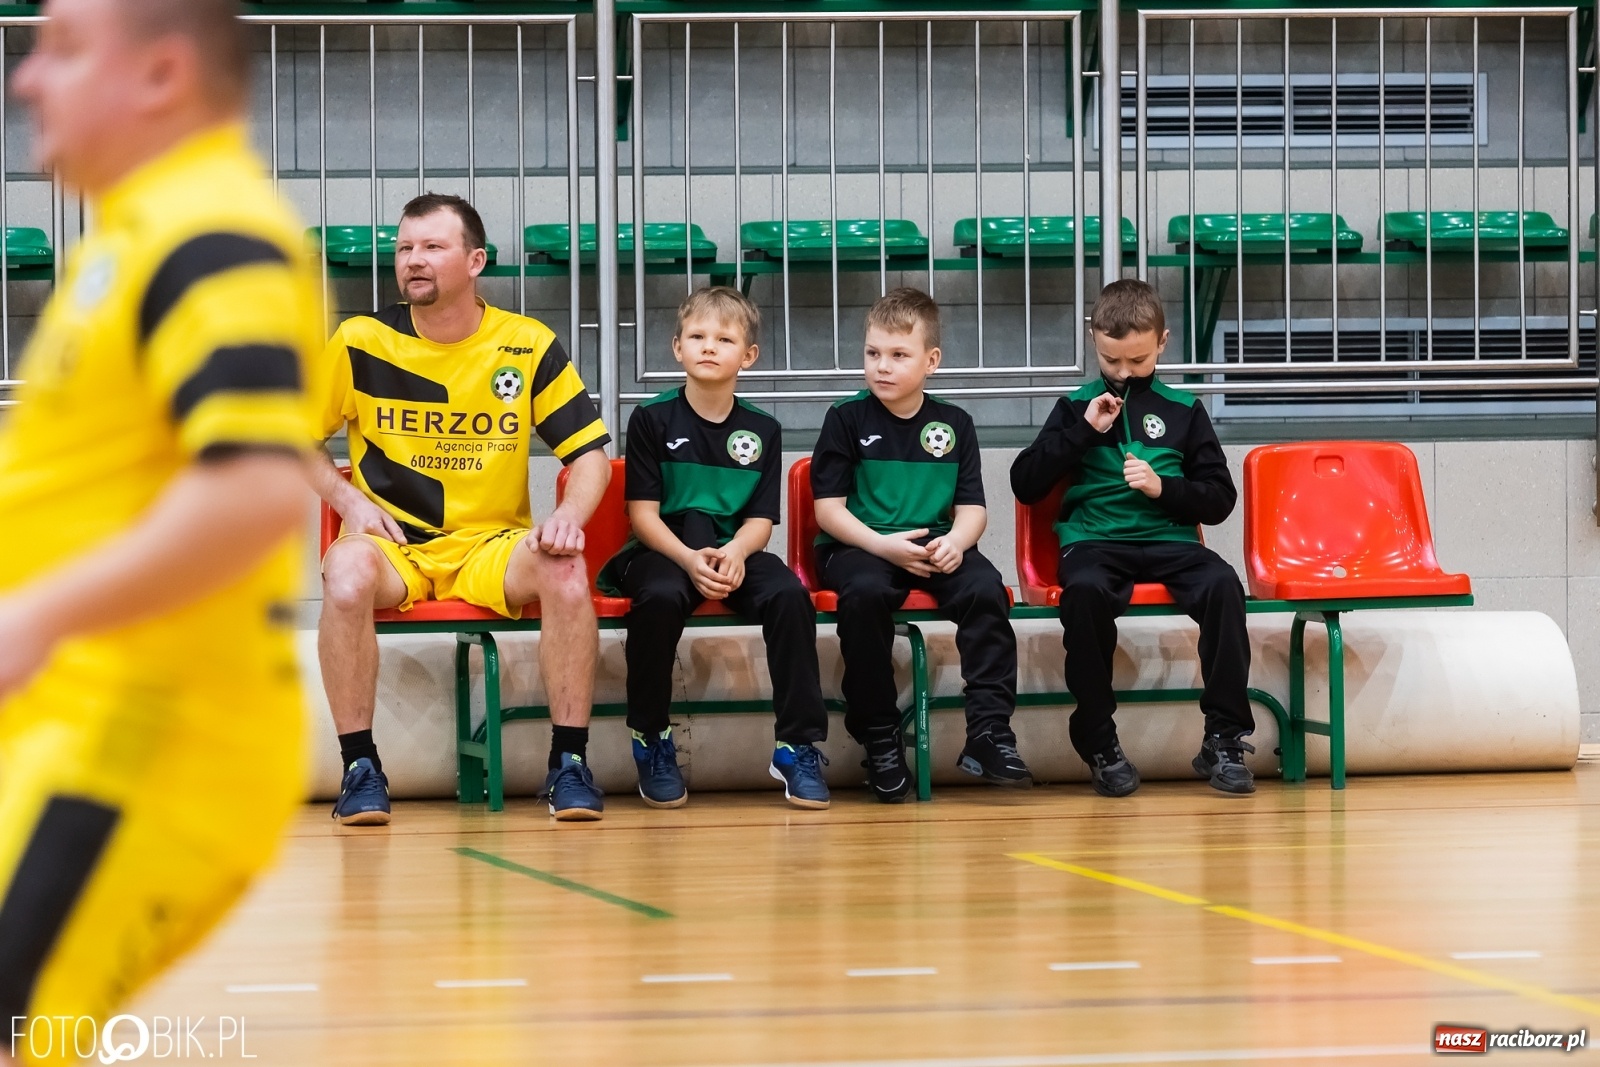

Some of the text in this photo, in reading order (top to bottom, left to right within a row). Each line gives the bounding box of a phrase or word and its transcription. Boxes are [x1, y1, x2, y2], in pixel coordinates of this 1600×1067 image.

[377, 407, 519, 435] HERZOG
[435, 441, 518, 453] Agencja Pracy
[411, 455, 482, 471] 602392876
